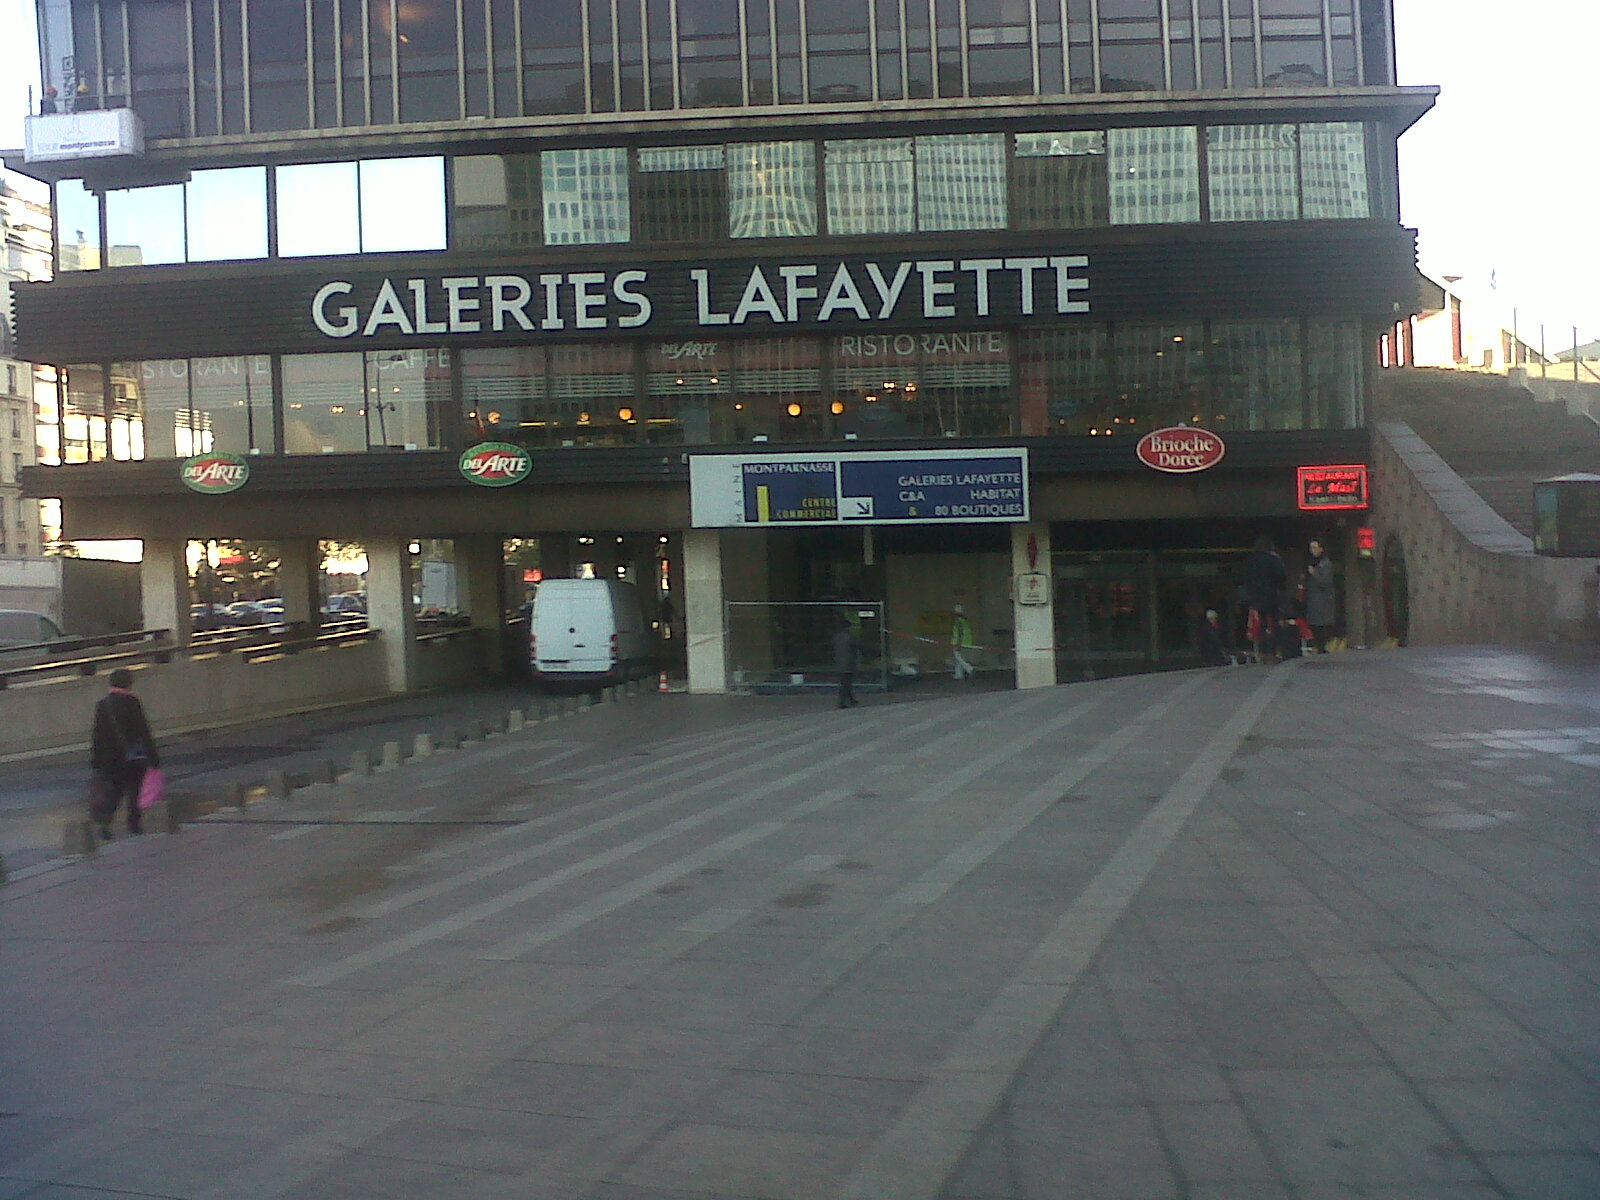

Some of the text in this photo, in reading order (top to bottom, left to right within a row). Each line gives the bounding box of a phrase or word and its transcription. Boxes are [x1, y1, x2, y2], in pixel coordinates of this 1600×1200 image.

[311, 255, 1090, 338] GALERIES LAFAYETTE
[668, 340, 718, 360] ARTE
[841, 331, 1003, 356] RISTORANTE
[1150, 433, 1214, 453] Brioche
[195, 462, 245, 486] ARTE
[470, 454, 527, 478] ARTE
[744, 463, 834, 474] MONTPARNASSE
[898, 473, 1021, 486] GALERIES LAFAYETTE
[899, 488, 1021, 501] C&A HABITAT
[802, 498, 837, 508] CENTRE
[952, 503, 1022, 516] BOUTIQUES
[776, 509, 837, 519] COMMERCIAL
